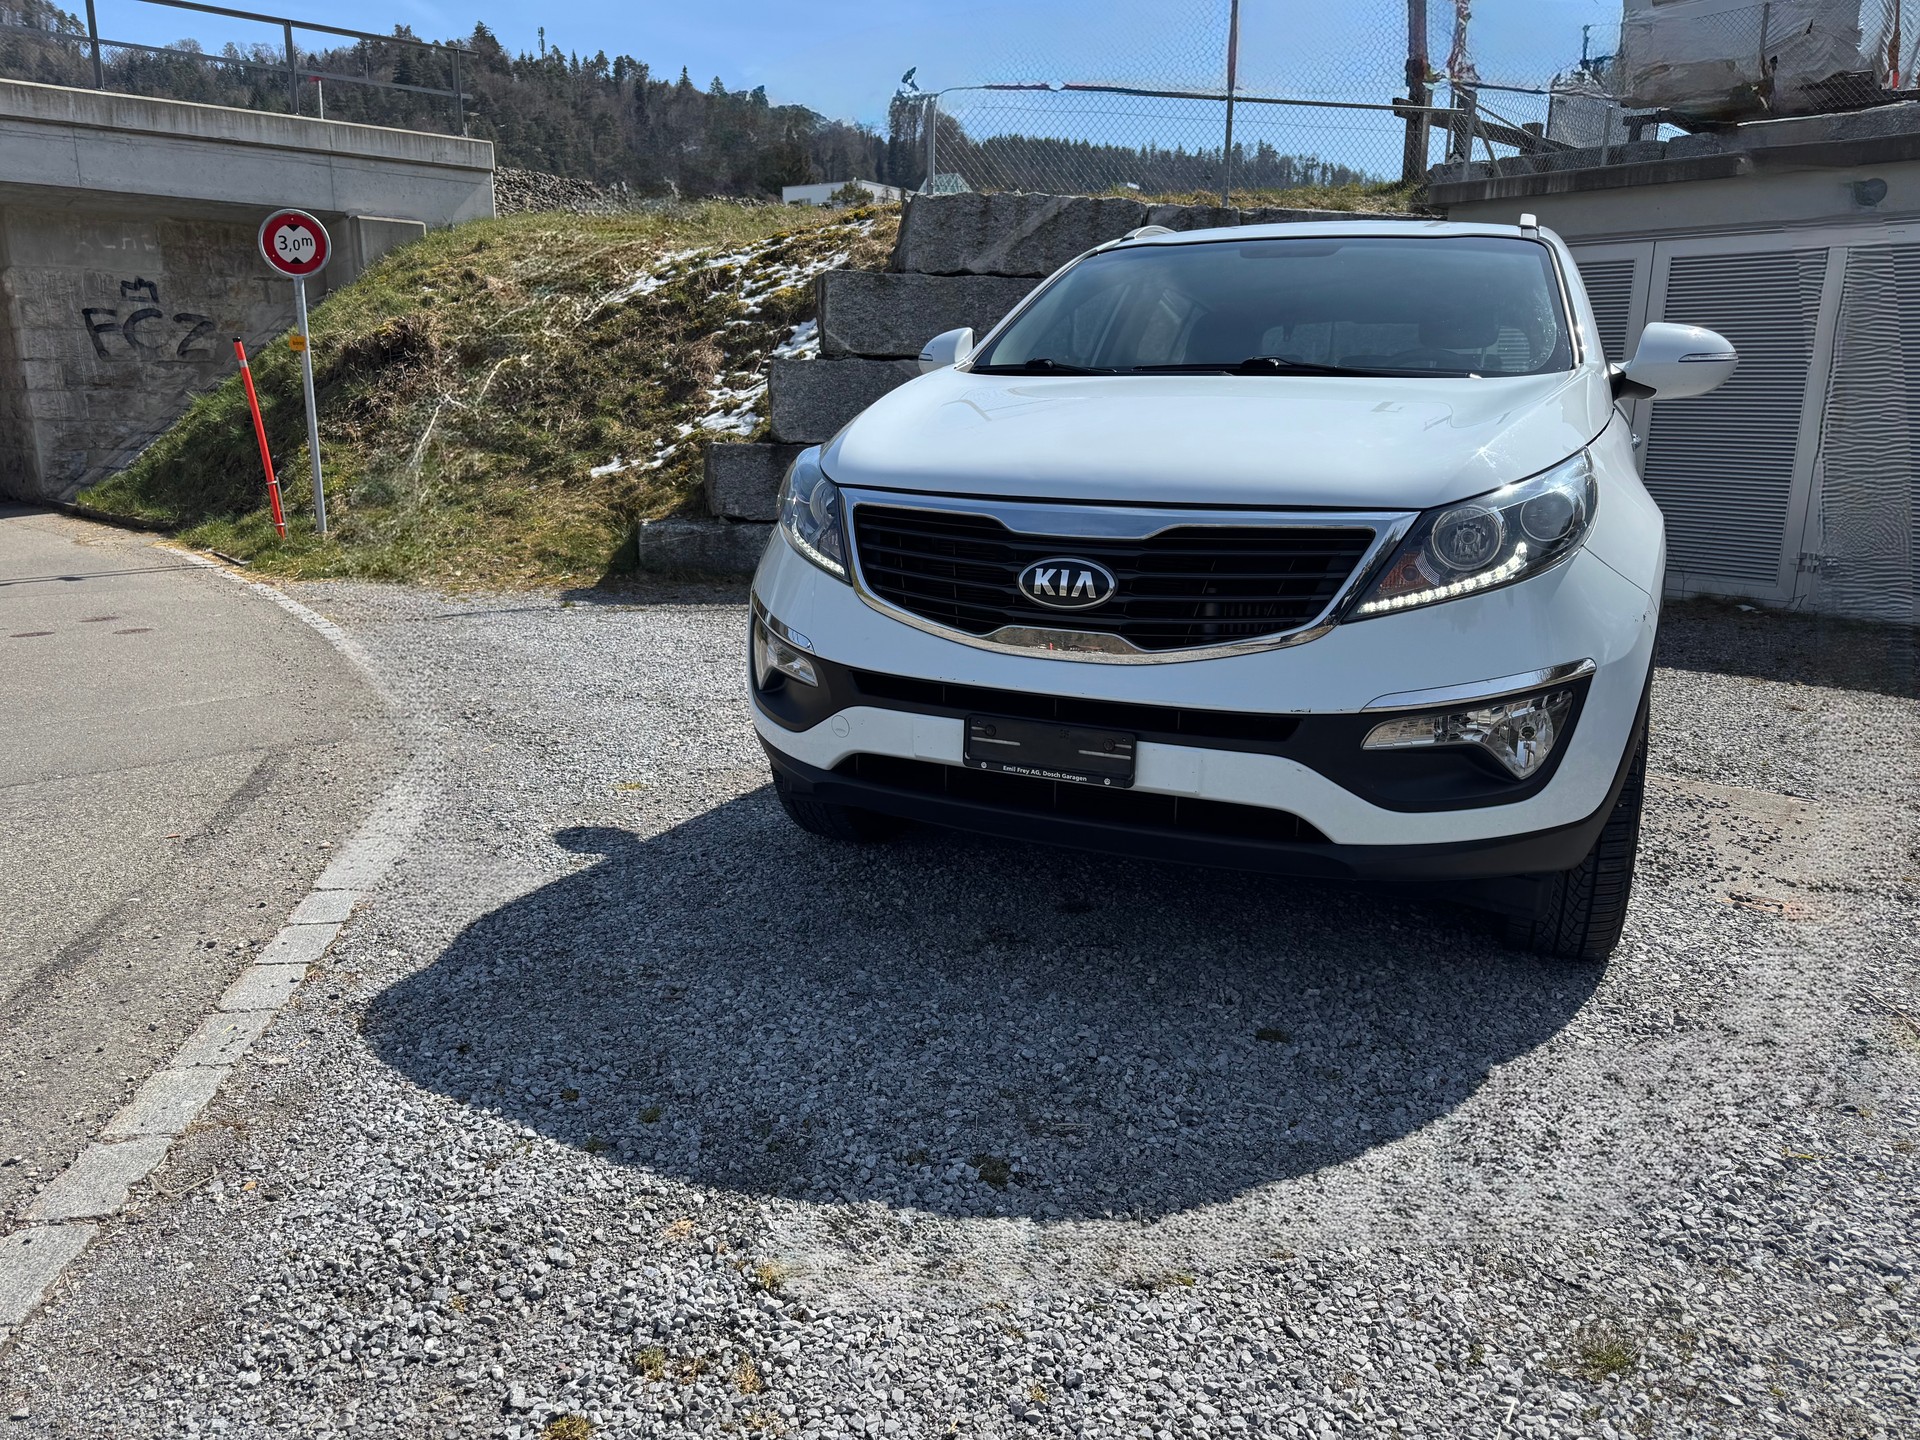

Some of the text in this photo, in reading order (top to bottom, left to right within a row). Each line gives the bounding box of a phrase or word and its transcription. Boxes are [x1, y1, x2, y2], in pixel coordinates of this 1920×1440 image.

[82, 308, 216, 361] FCZ
[1034, 568, 1097, 598] KIA
[1017, 767, 1030, 775] Frey
[1043, 770, 1061, 778] Dosch
[1062, 773, 1087, 782] Garagen
